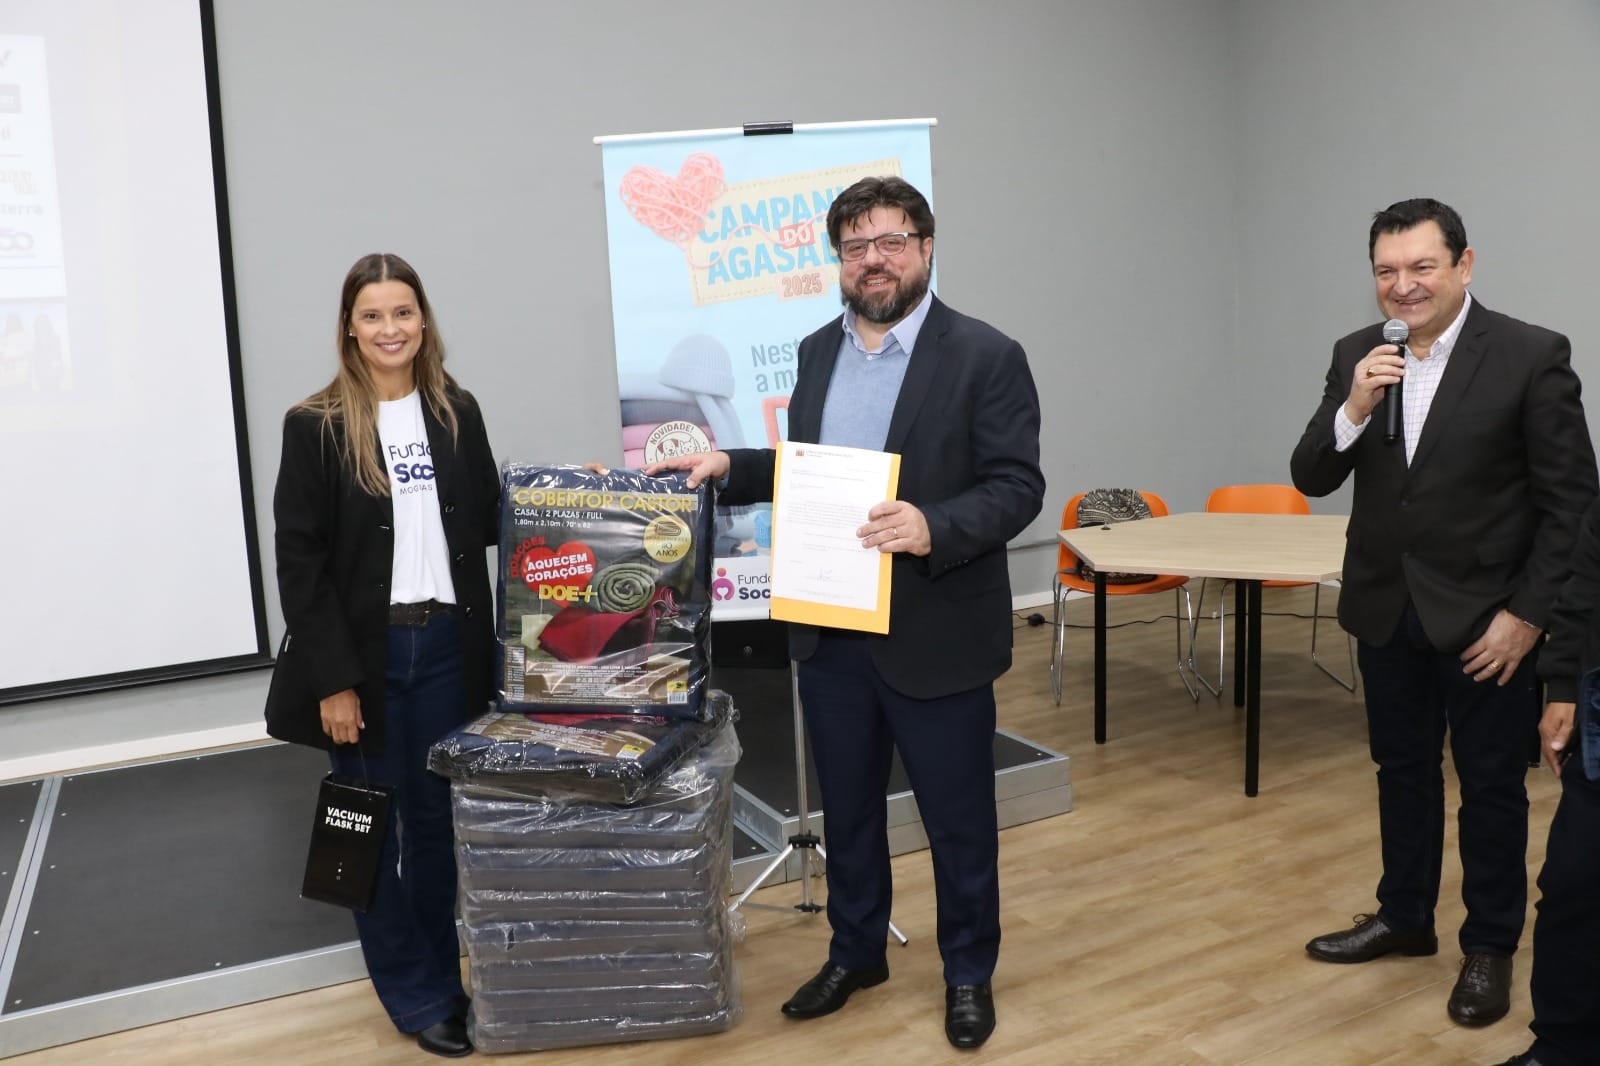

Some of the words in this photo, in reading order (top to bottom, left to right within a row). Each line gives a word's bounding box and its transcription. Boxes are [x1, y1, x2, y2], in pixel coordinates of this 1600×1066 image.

[698, 187, 844, 244] CAMPAN
[784, 221, 811, 247] DO
[782, 272, 823, 298] 2025
[755, 373, 768, 393] a
[650, 422, 695, 446] NOVIDADE!
[515, 489, 614, 508] COBERTOR
[619, 494, 692, 513] CASTOR
[514, 508, 539, 517] CASAL
[553, 510, 580, 519] PLAZAS
[587, 512, 604, 520] FULL
[527, 552, 588, 572] AQUECEM
[525, 564, 594, 583] CORAÇÕES
[737, 573, 771, 584] Fund
[325, 817, 352, 831] FLASK
[354, 823, 371, 834] SET
[327, 806, 372, 825] VACUUM
